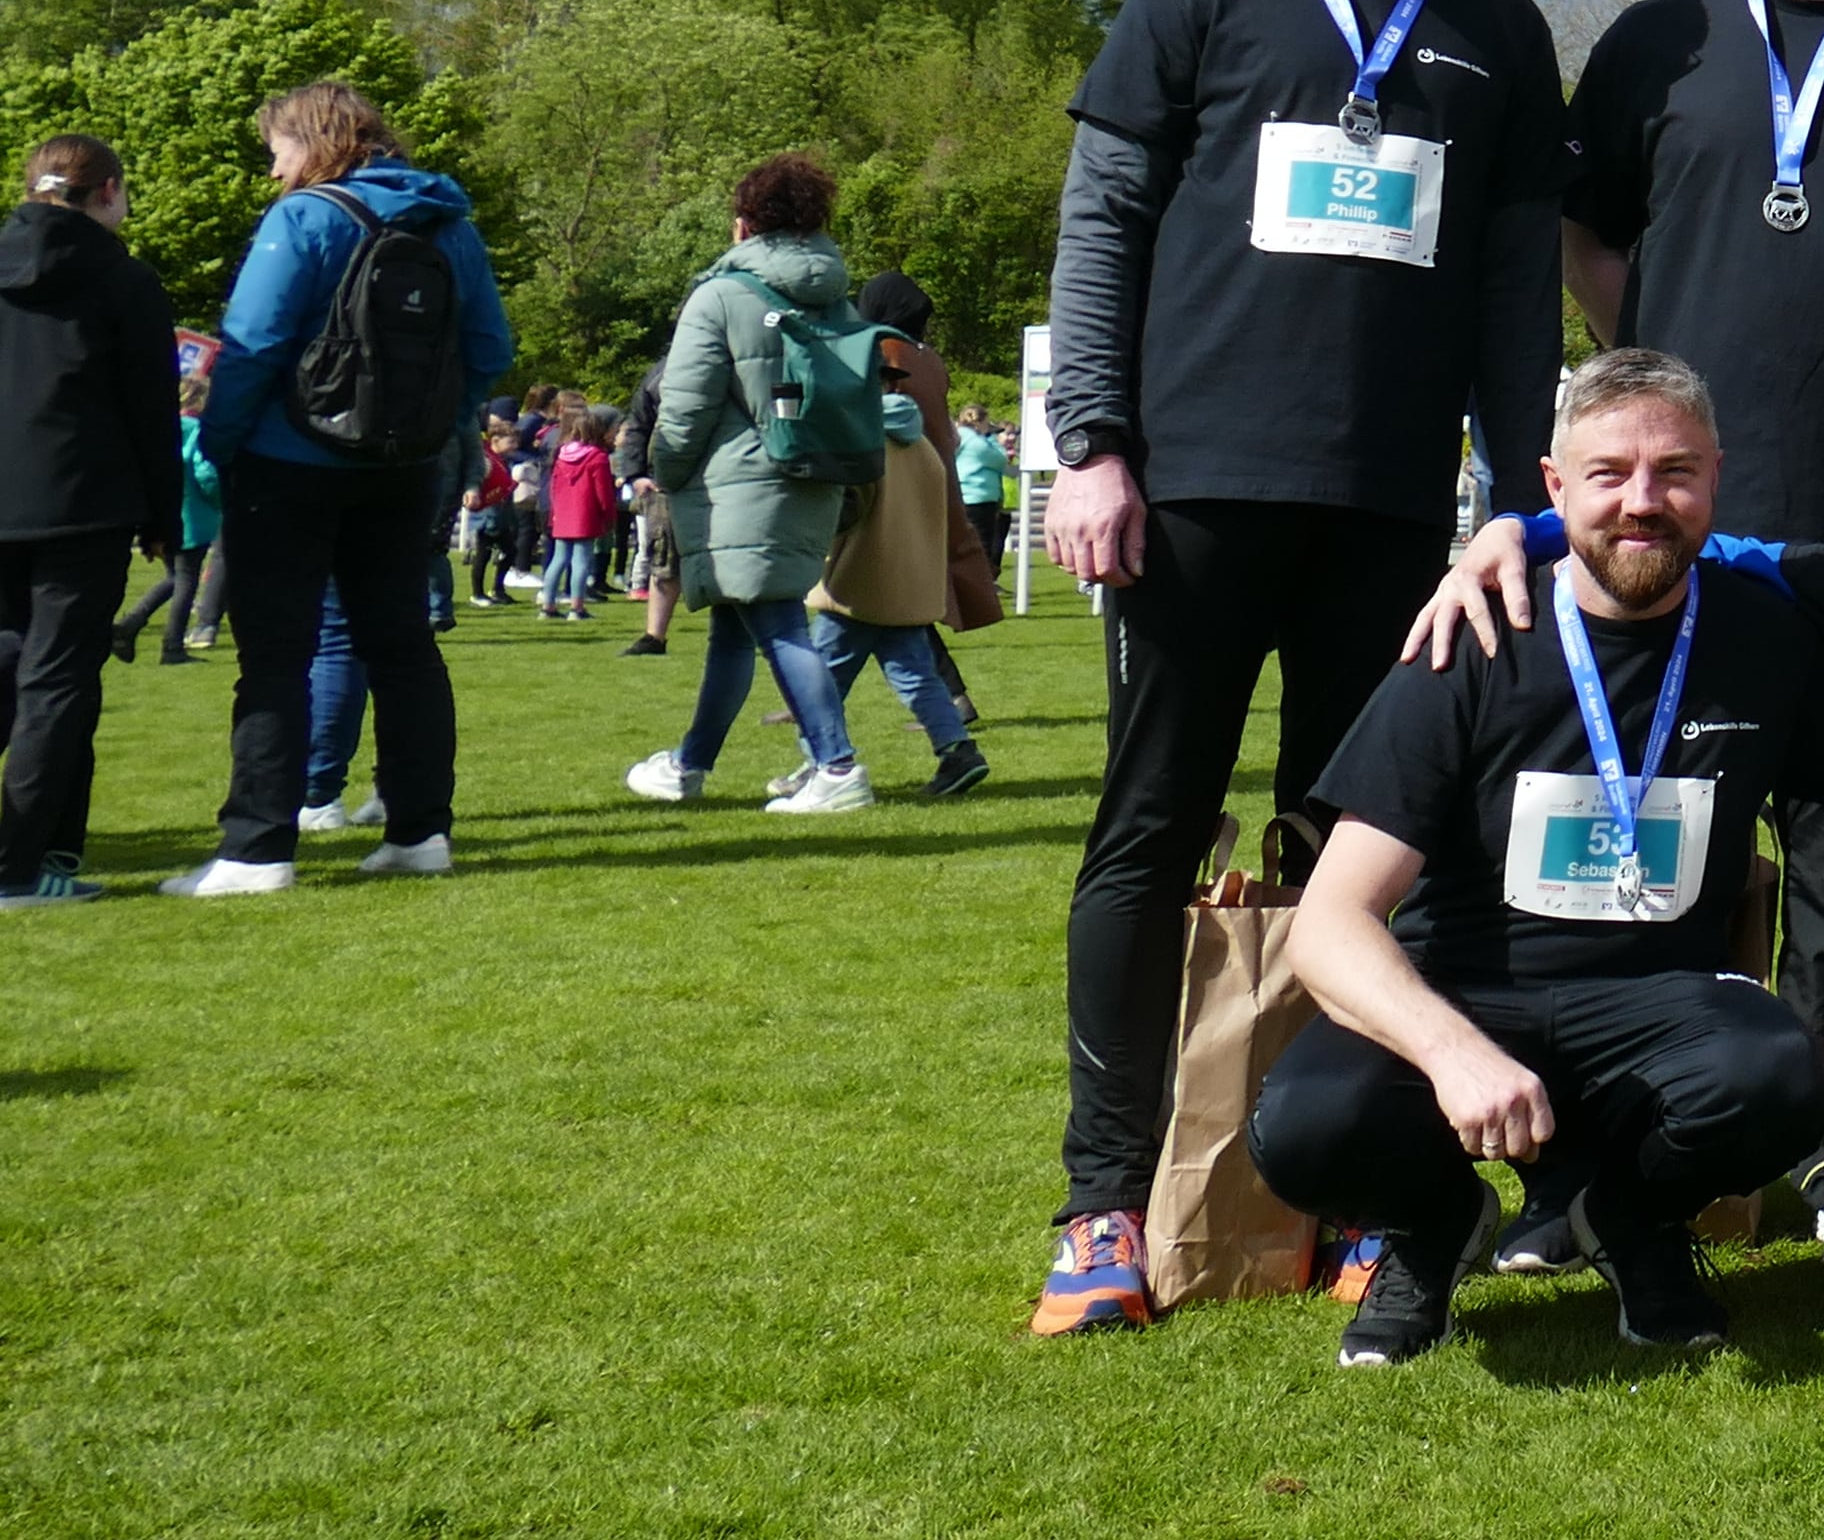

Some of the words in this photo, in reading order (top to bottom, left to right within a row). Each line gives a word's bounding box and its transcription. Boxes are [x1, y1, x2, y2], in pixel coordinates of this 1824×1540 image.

[1331, 167, 1379, 200] 52
[1327, 202, 1378, 223] Phillip
[1567, 862, 1649, 877] Sebasn
